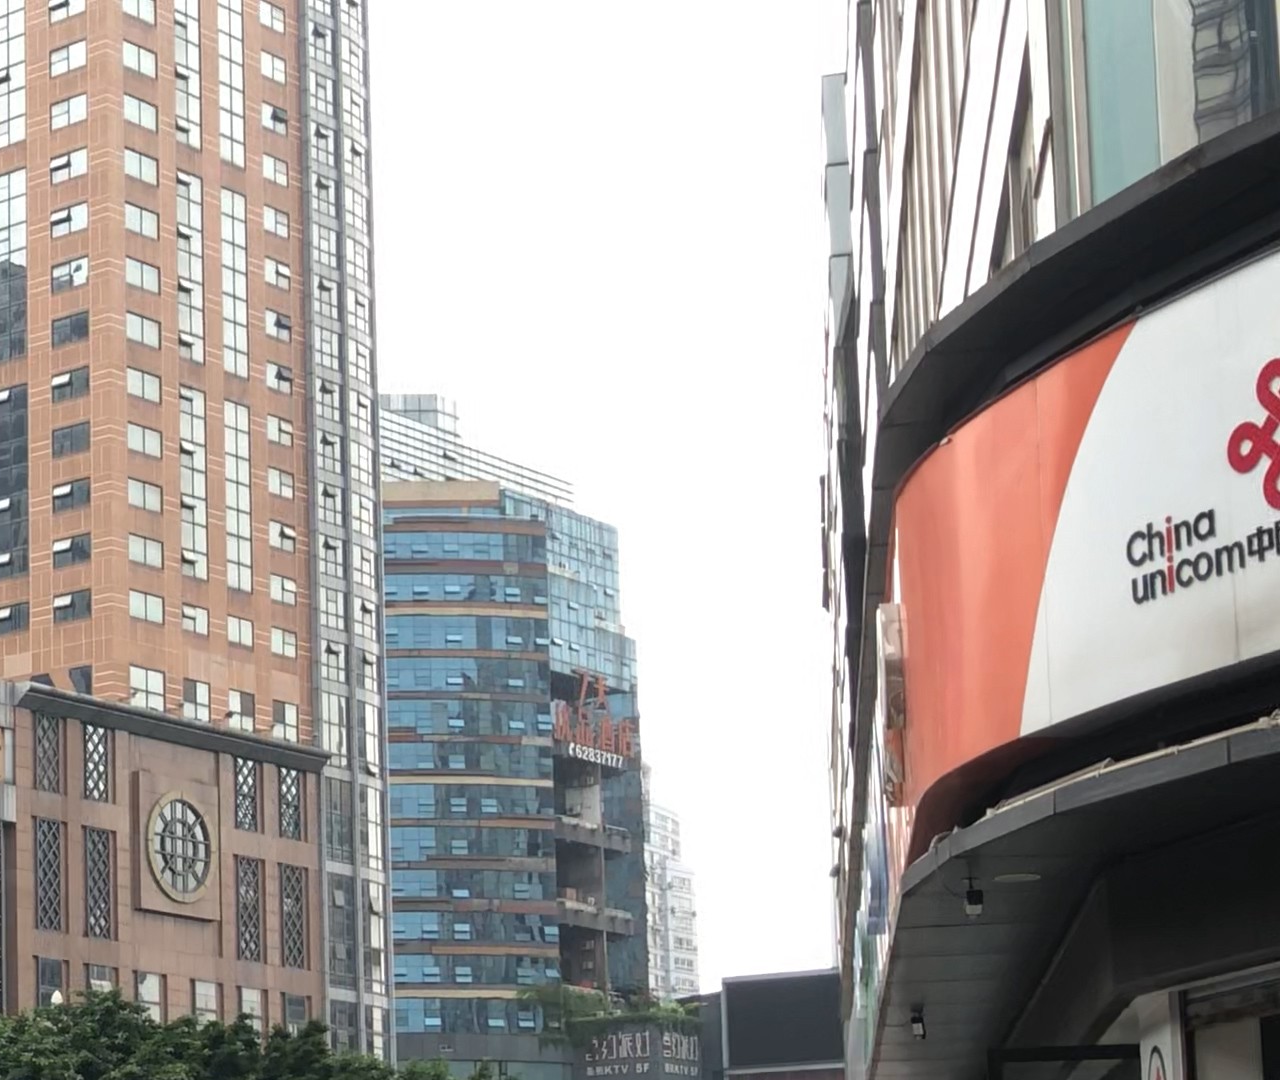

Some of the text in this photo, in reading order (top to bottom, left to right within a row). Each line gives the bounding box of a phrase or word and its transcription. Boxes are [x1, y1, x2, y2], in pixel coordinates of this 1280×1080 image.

[1127, 508, 1217, 567] China
[1131, 521, 1280, 605] unicom 中
[575, 743, 624, 769] 62837177
